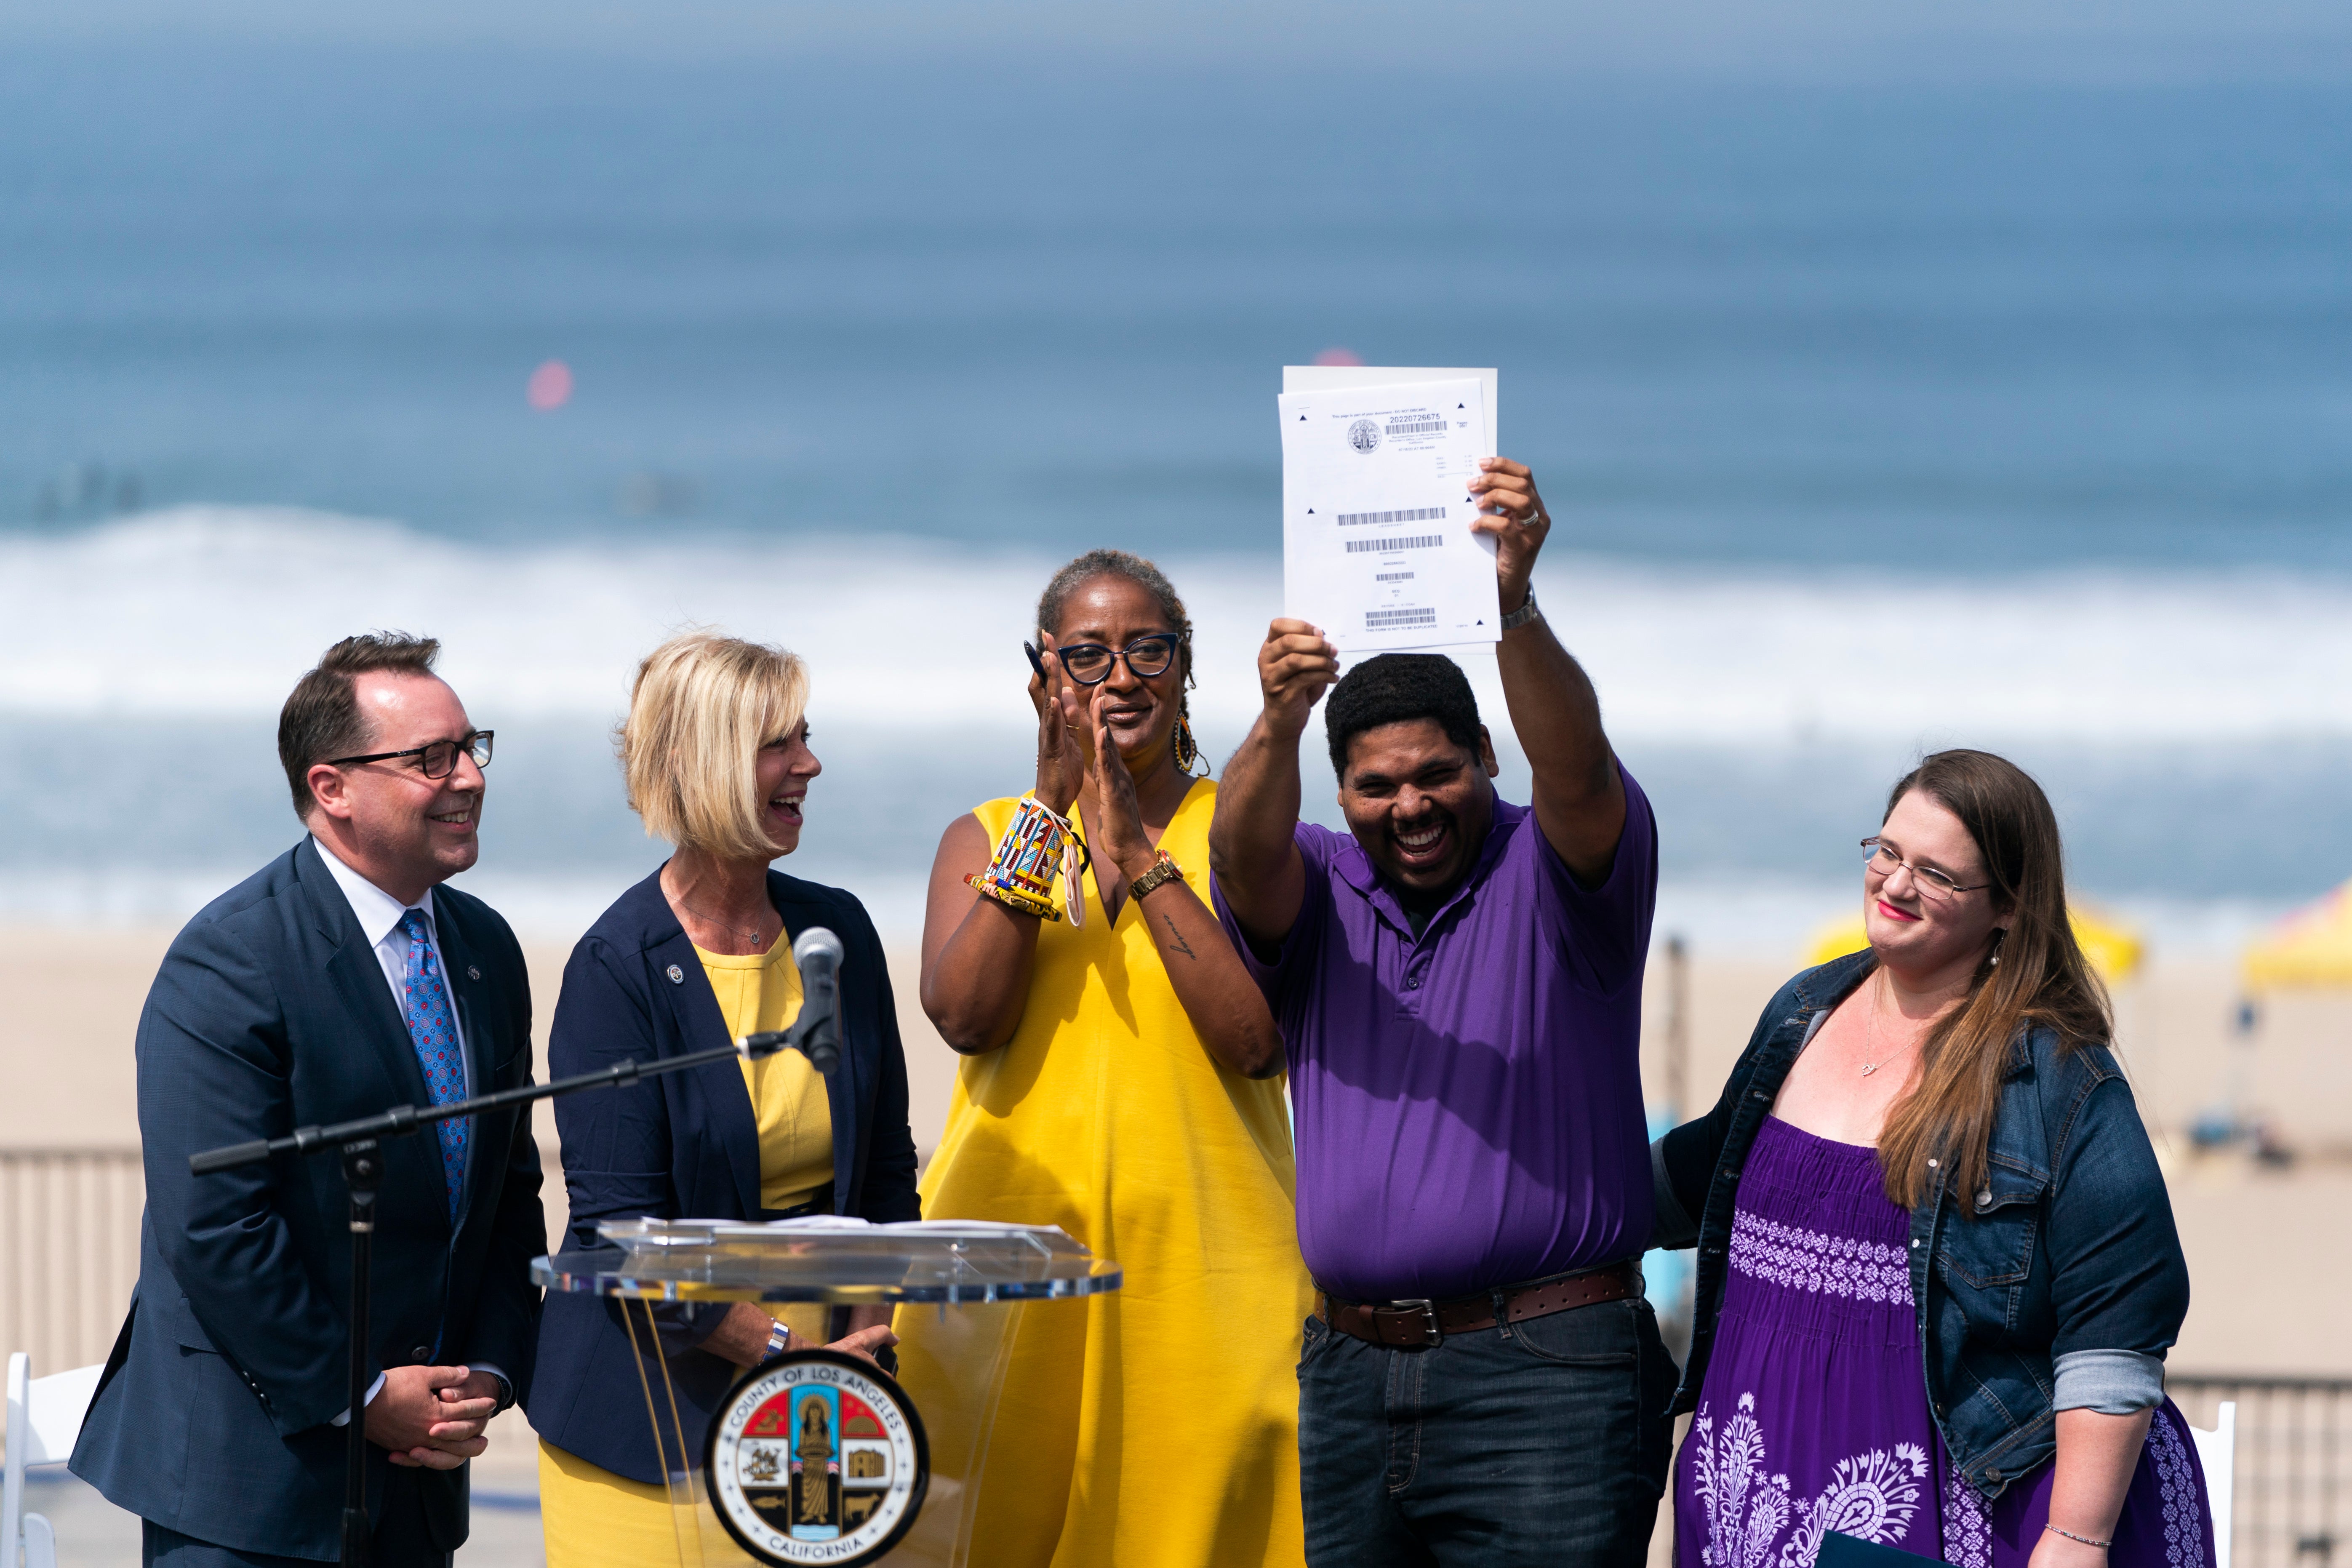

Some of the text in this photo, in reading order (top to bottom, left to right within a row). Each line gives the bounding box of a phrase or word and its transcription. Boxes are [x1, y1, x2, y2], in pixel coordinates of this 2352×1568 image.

[1390, 413, 1440, 423] 20220726675
[1163, 912, 1196, 960] courage
[730, 1367, 901, 1430] COUNTY OF LOS ANGELES
[770, 1537, 864, 1558] CALIFORNIA
